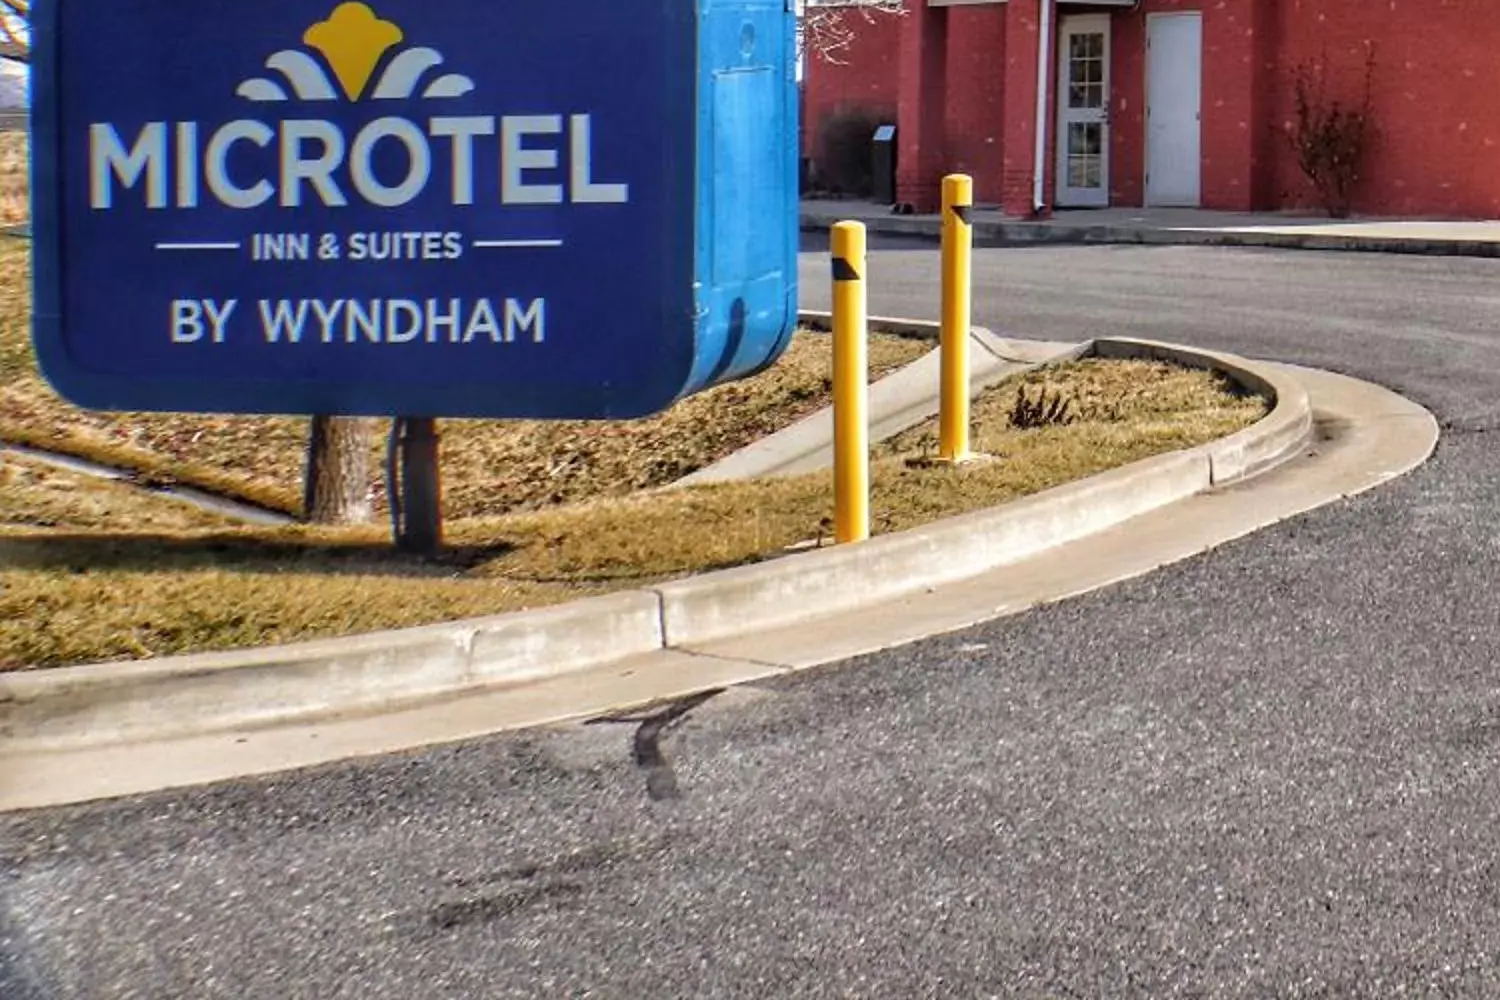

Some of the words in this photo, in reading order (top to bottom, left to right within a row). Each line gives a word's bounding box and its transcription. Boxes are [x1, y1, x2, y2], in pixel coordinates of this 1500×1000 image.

[89, 114, 628, 209] MICROTEL
[252, 233, 309, 260] INN
[317, 233, 340, 259] &
[348, 231, 463, 259] SUITES
[171, 299, 237, 342] BY
[258, 298, 545, 343] WYNDHAM
